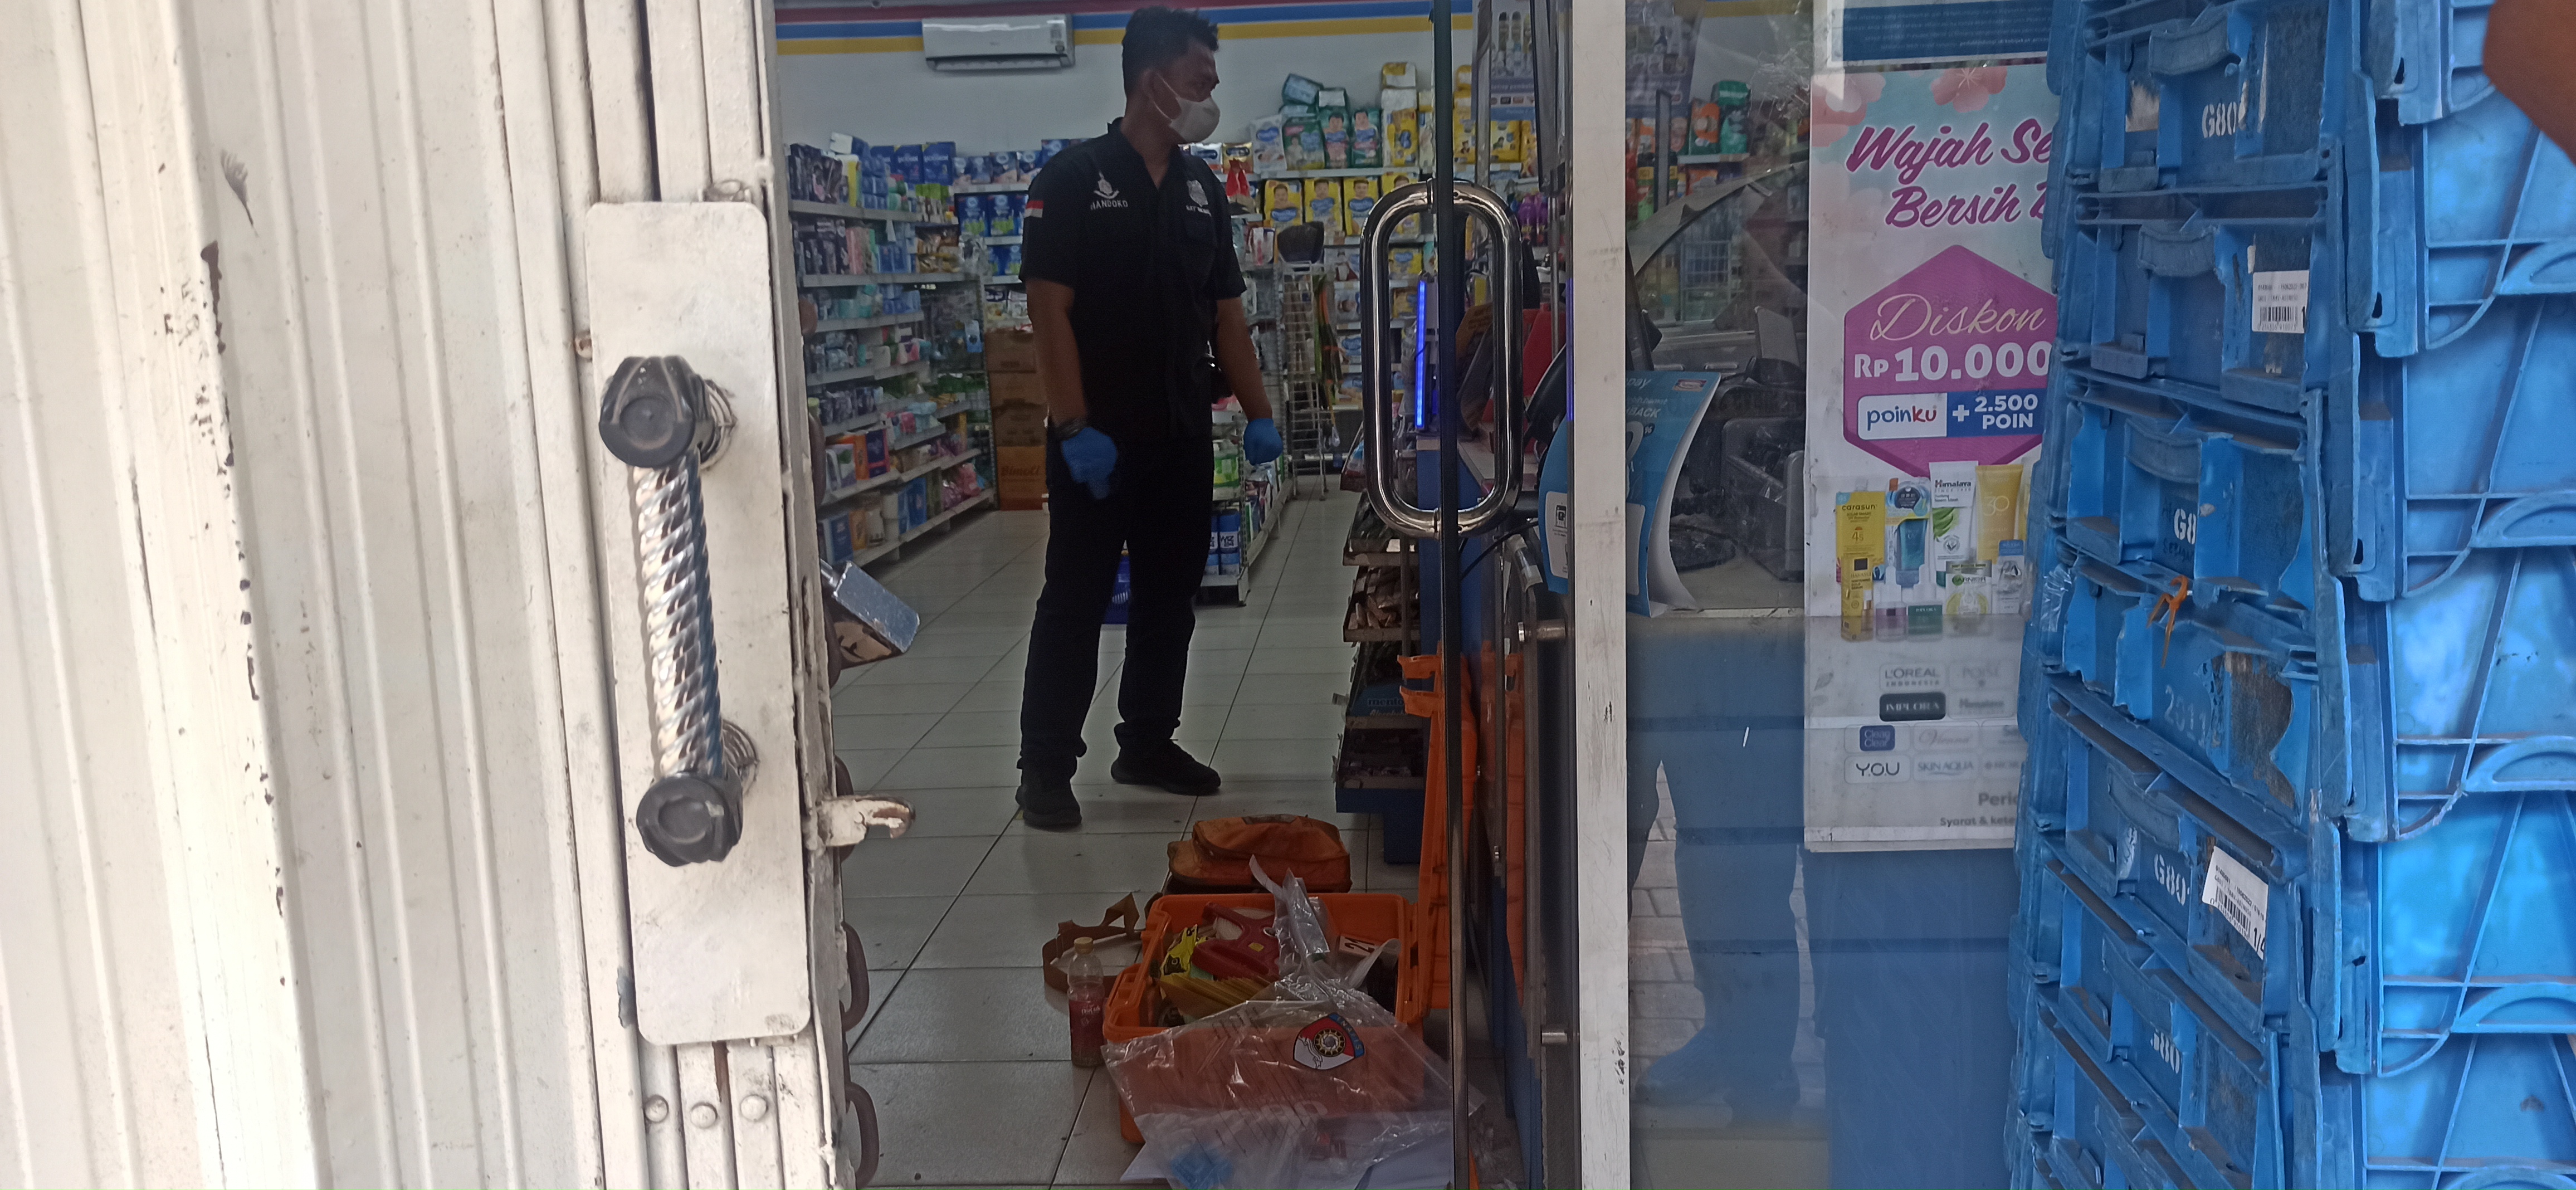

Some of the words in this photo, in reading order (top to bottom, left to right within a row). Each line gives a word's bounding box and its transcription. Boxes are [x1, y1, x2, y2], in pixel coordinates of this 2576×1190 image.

[1846, 122, 1993, 185] Wajah
[1885, 183, 2021, 228] Bersih
[1870, 294, 2046, 340] Diskon
[1854, 354, 1889, 378] Rp
[1895, 341, 2052, 381] 10.000
[1975, 394, 2038, 412] 2.500
[1867, 405, 1936, 431] poinku
[1982, 413, 2033, 430] POIN
[1856, 762, 1900, 777] Y.O.U
[1918, 762, 1941, 772] SKIN
[1940, 817, 1977, 827] Syarat
[2154, 854, 2190, 906] G80
